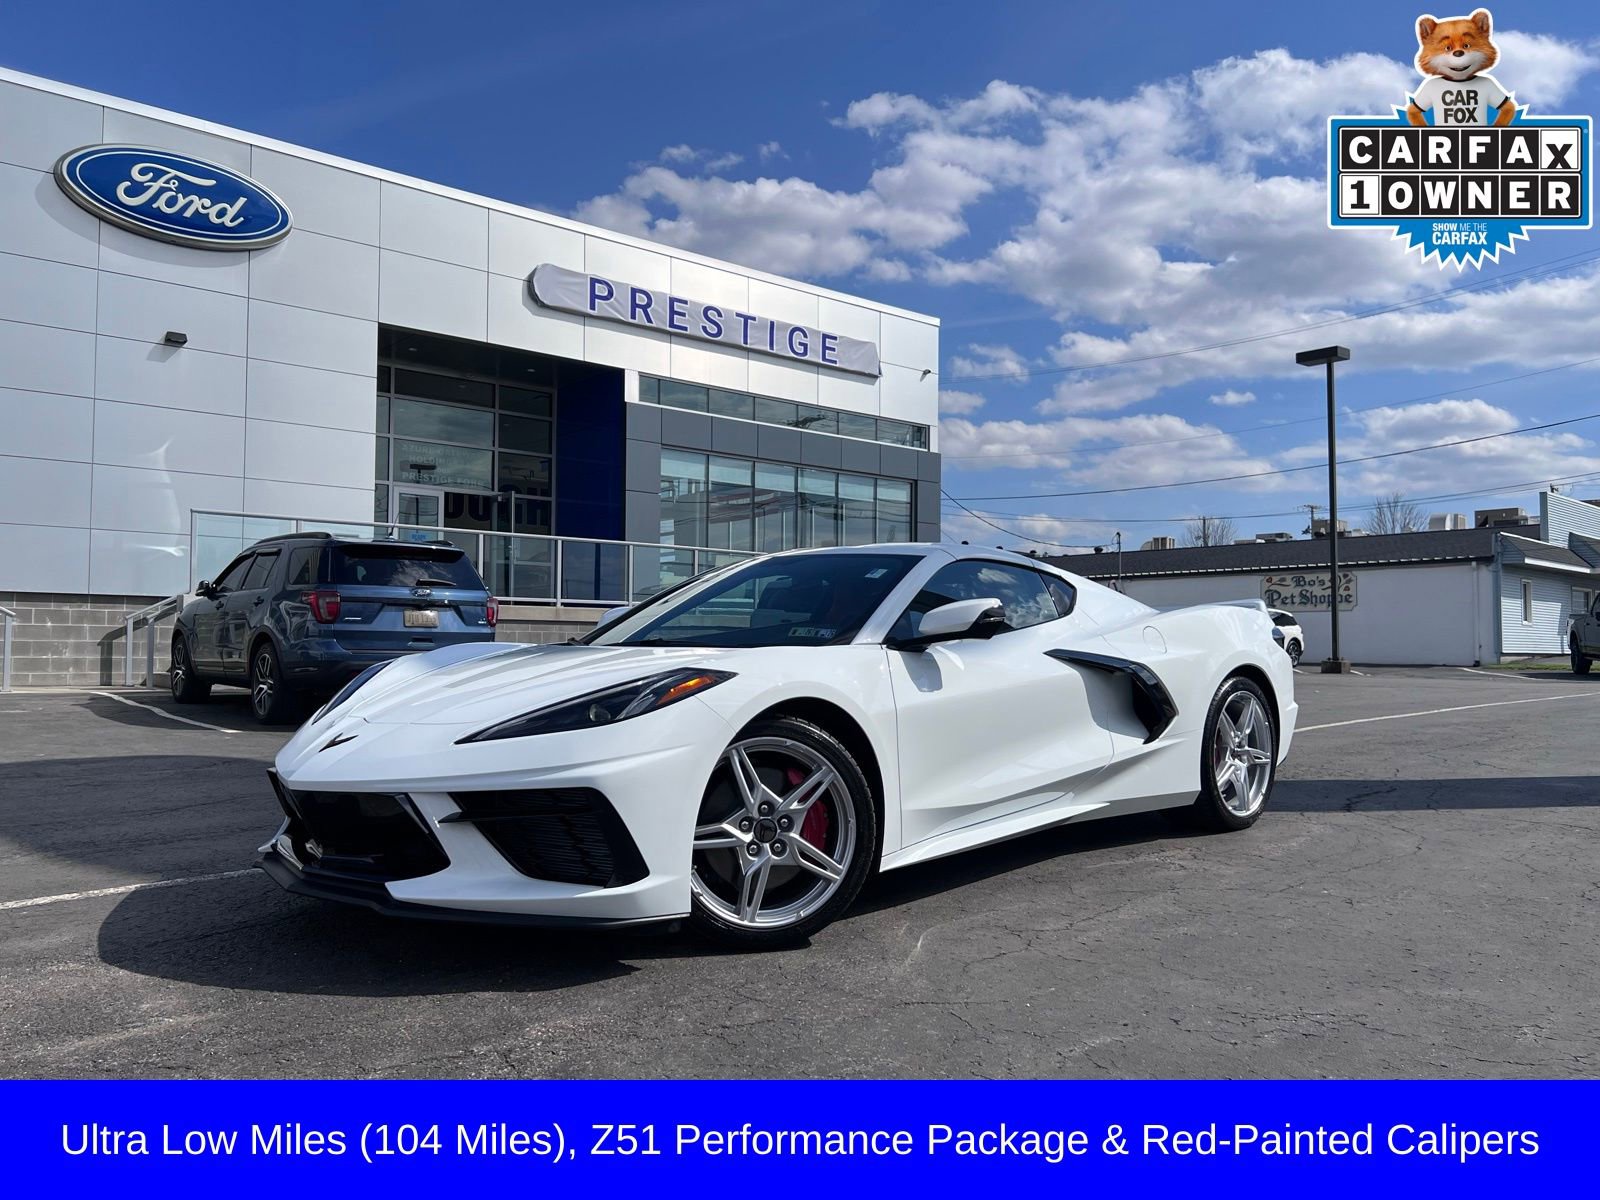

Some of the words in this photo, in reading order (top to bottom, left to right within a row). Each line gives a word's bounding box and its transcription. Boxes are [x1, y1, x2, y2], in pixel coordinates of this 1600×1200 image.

[116, 162, 247, 228] Ford
[588, 276, 838, 365] PRESTIGE
[1264, 589, 1296, 608] Pet
[1291, 575, 1325, 588] Bo's
